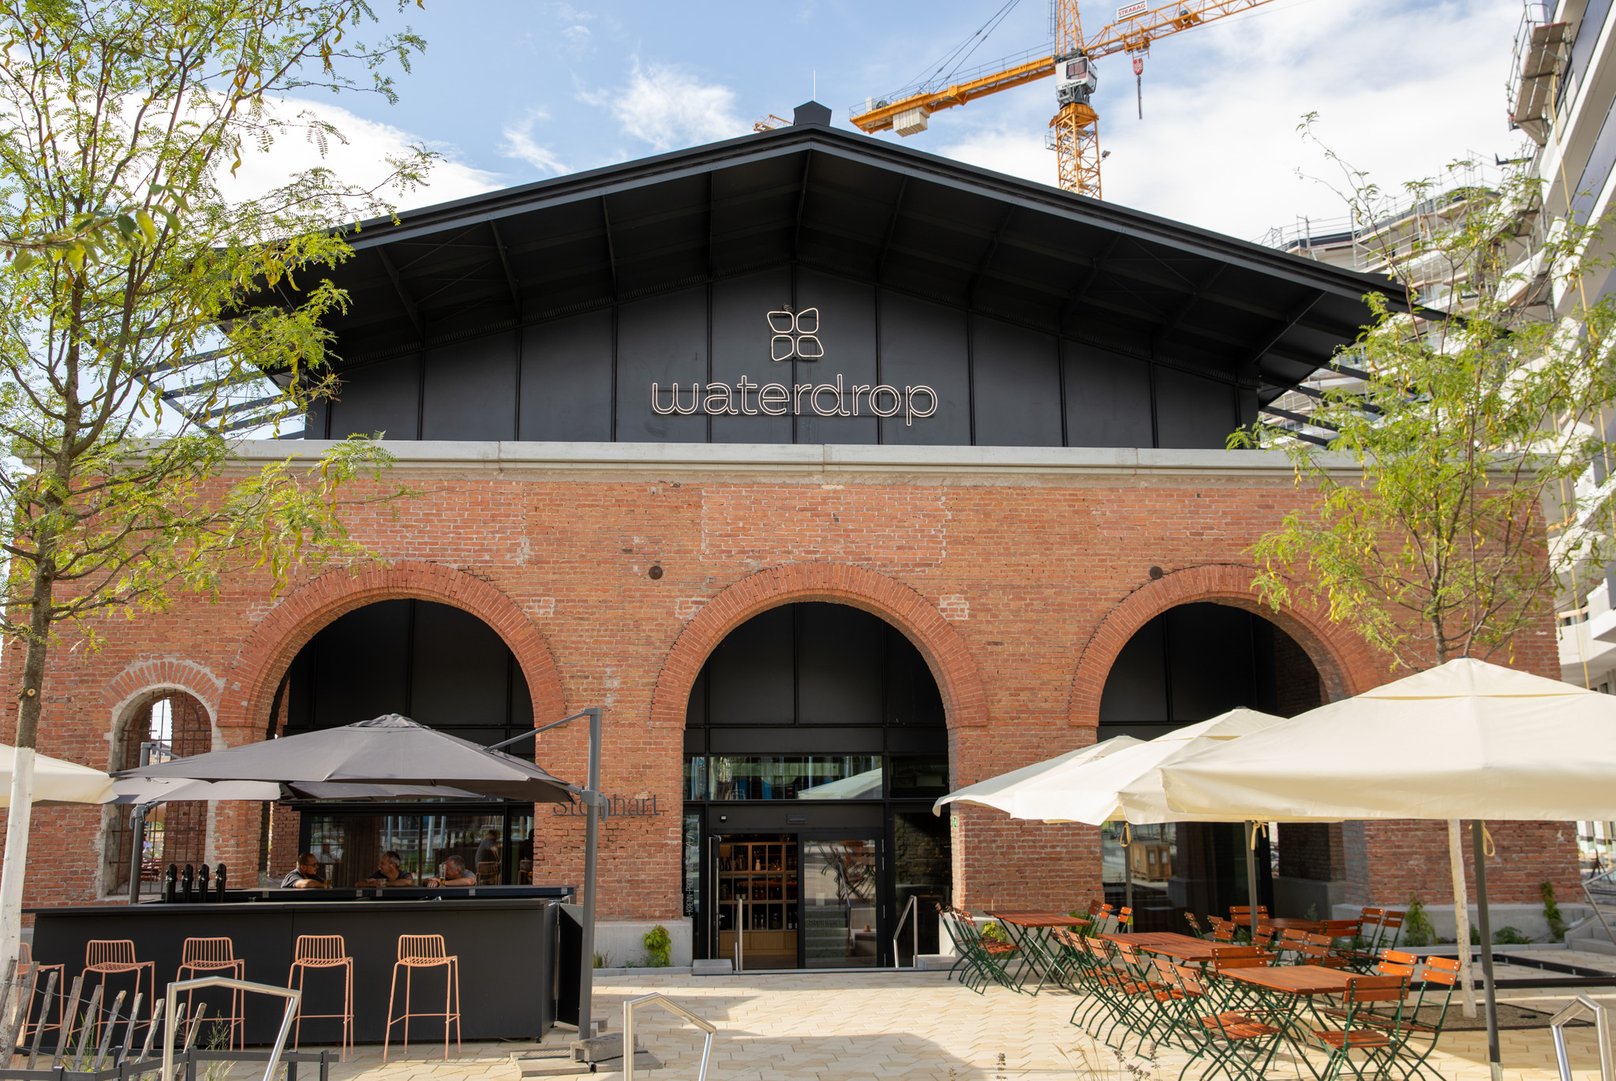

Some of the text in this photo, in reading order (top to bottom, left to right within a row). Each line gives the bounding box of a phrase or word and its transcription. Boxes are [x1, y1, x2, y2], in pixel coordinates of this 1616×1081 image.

[1118, 4, 1146, 16] STRABAG
[652, 374, 938, 426] waterdrop
[553, 793, 661, 817] Stehart
